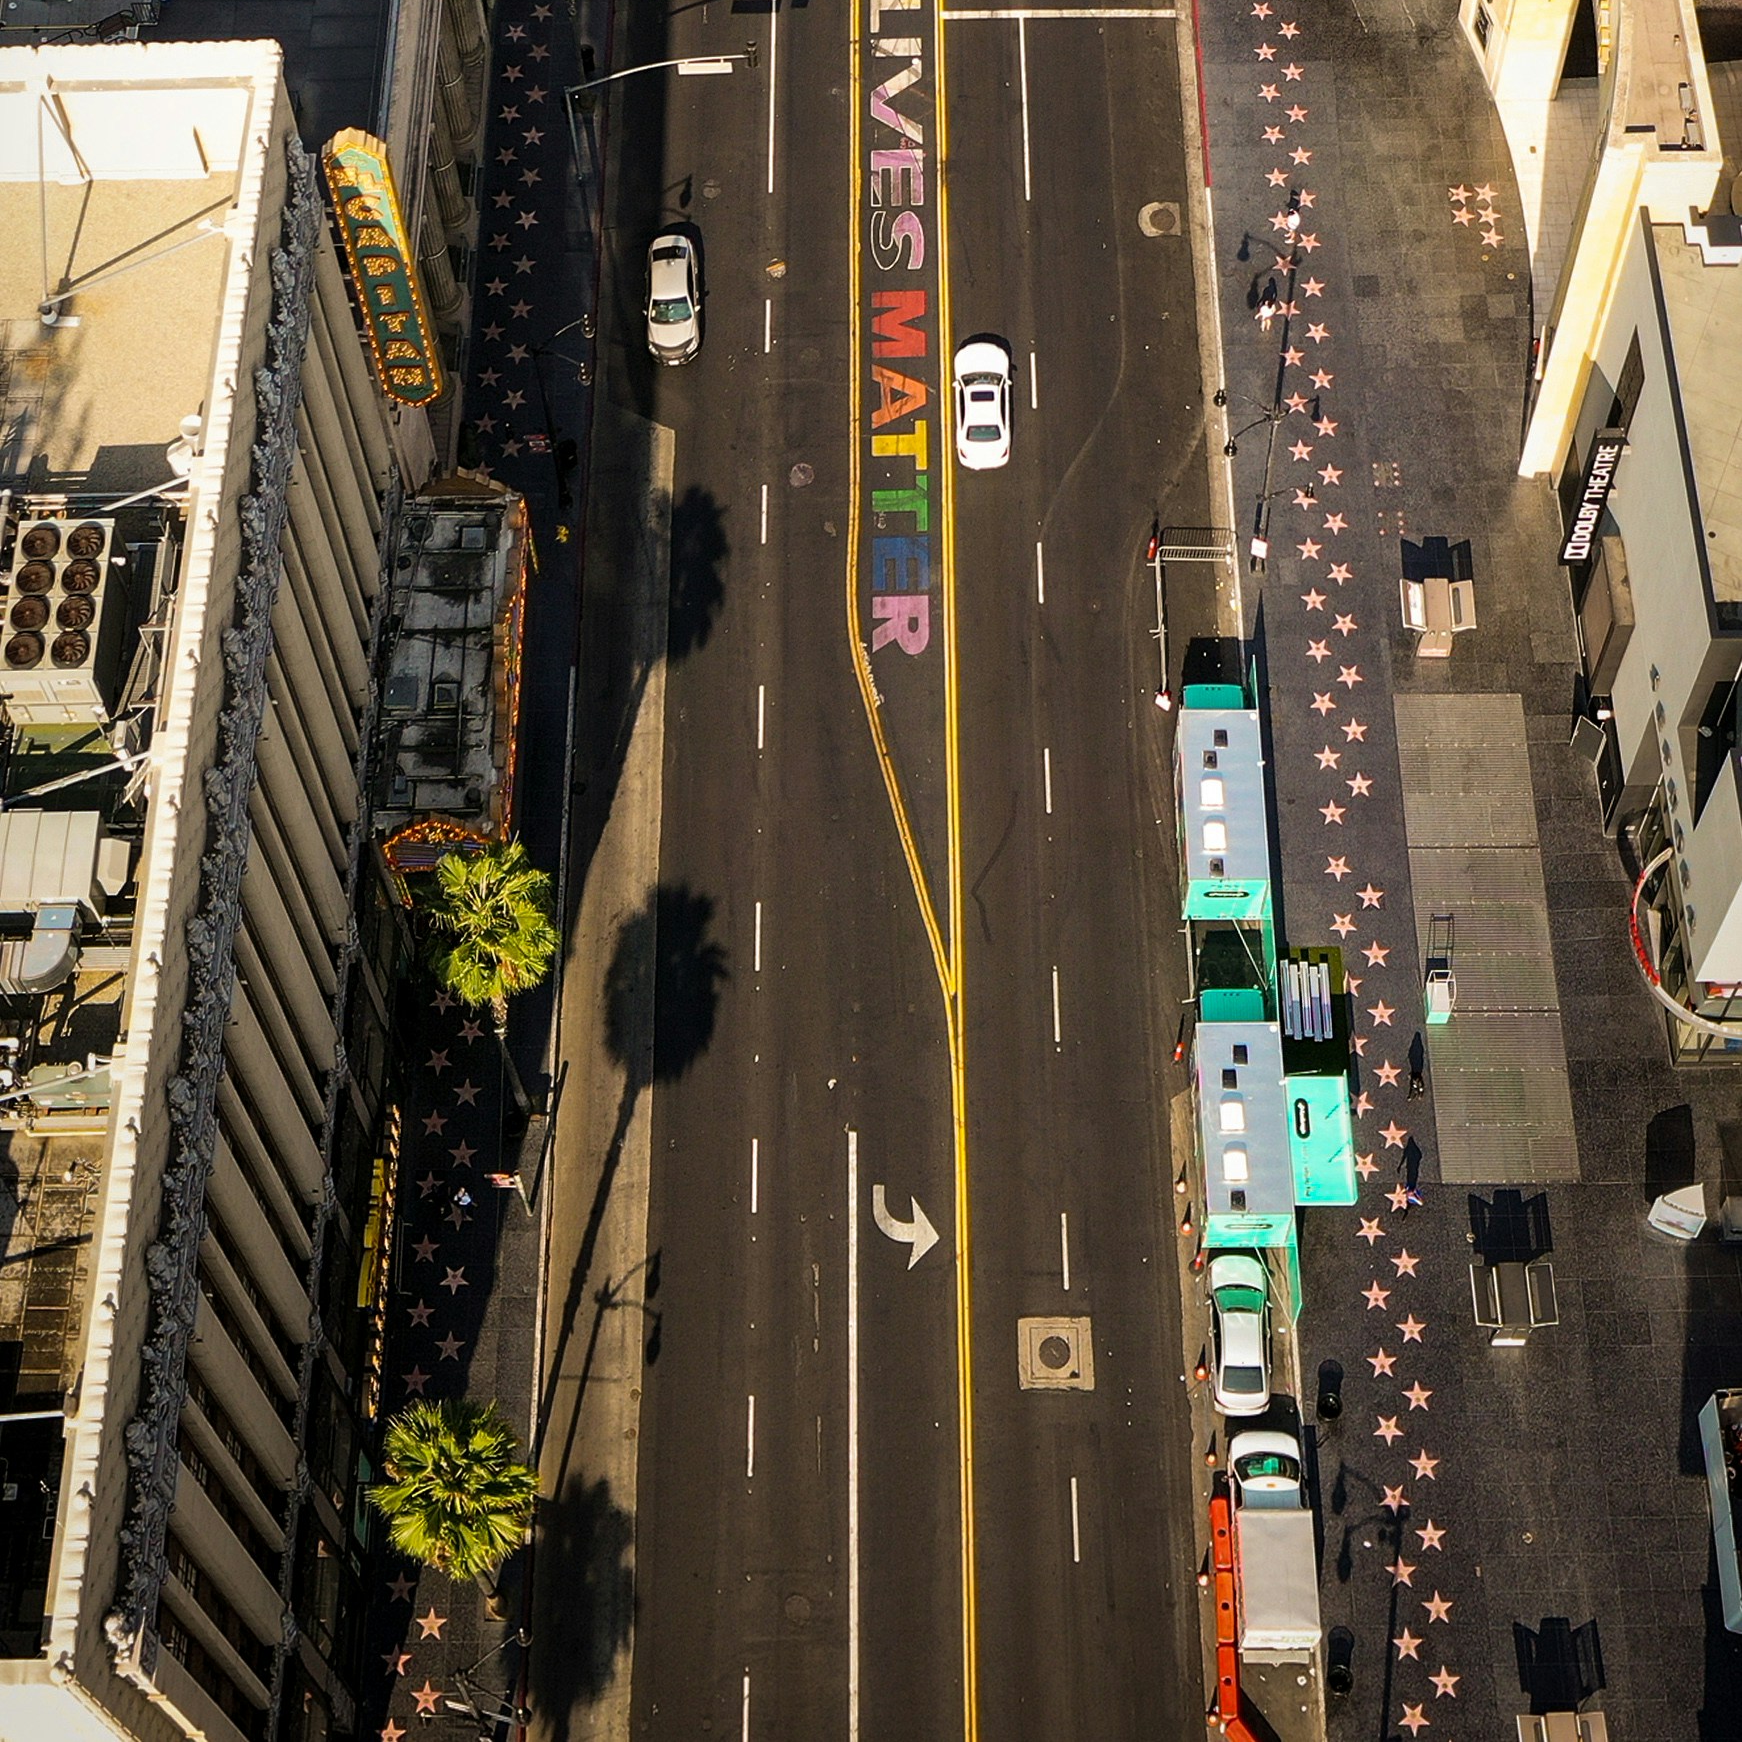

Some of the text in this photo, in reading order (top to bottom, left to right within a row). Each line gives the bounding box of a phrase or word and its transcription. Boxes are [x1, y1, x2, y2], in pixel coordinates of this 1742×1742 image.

[332, 165, 387, 193] EL
[345, 193, 425, 387] CAPITAN
[870, 289, 930, 659] MATTER
[1571, 444, 1619, 543] DOLBY THEATRE
